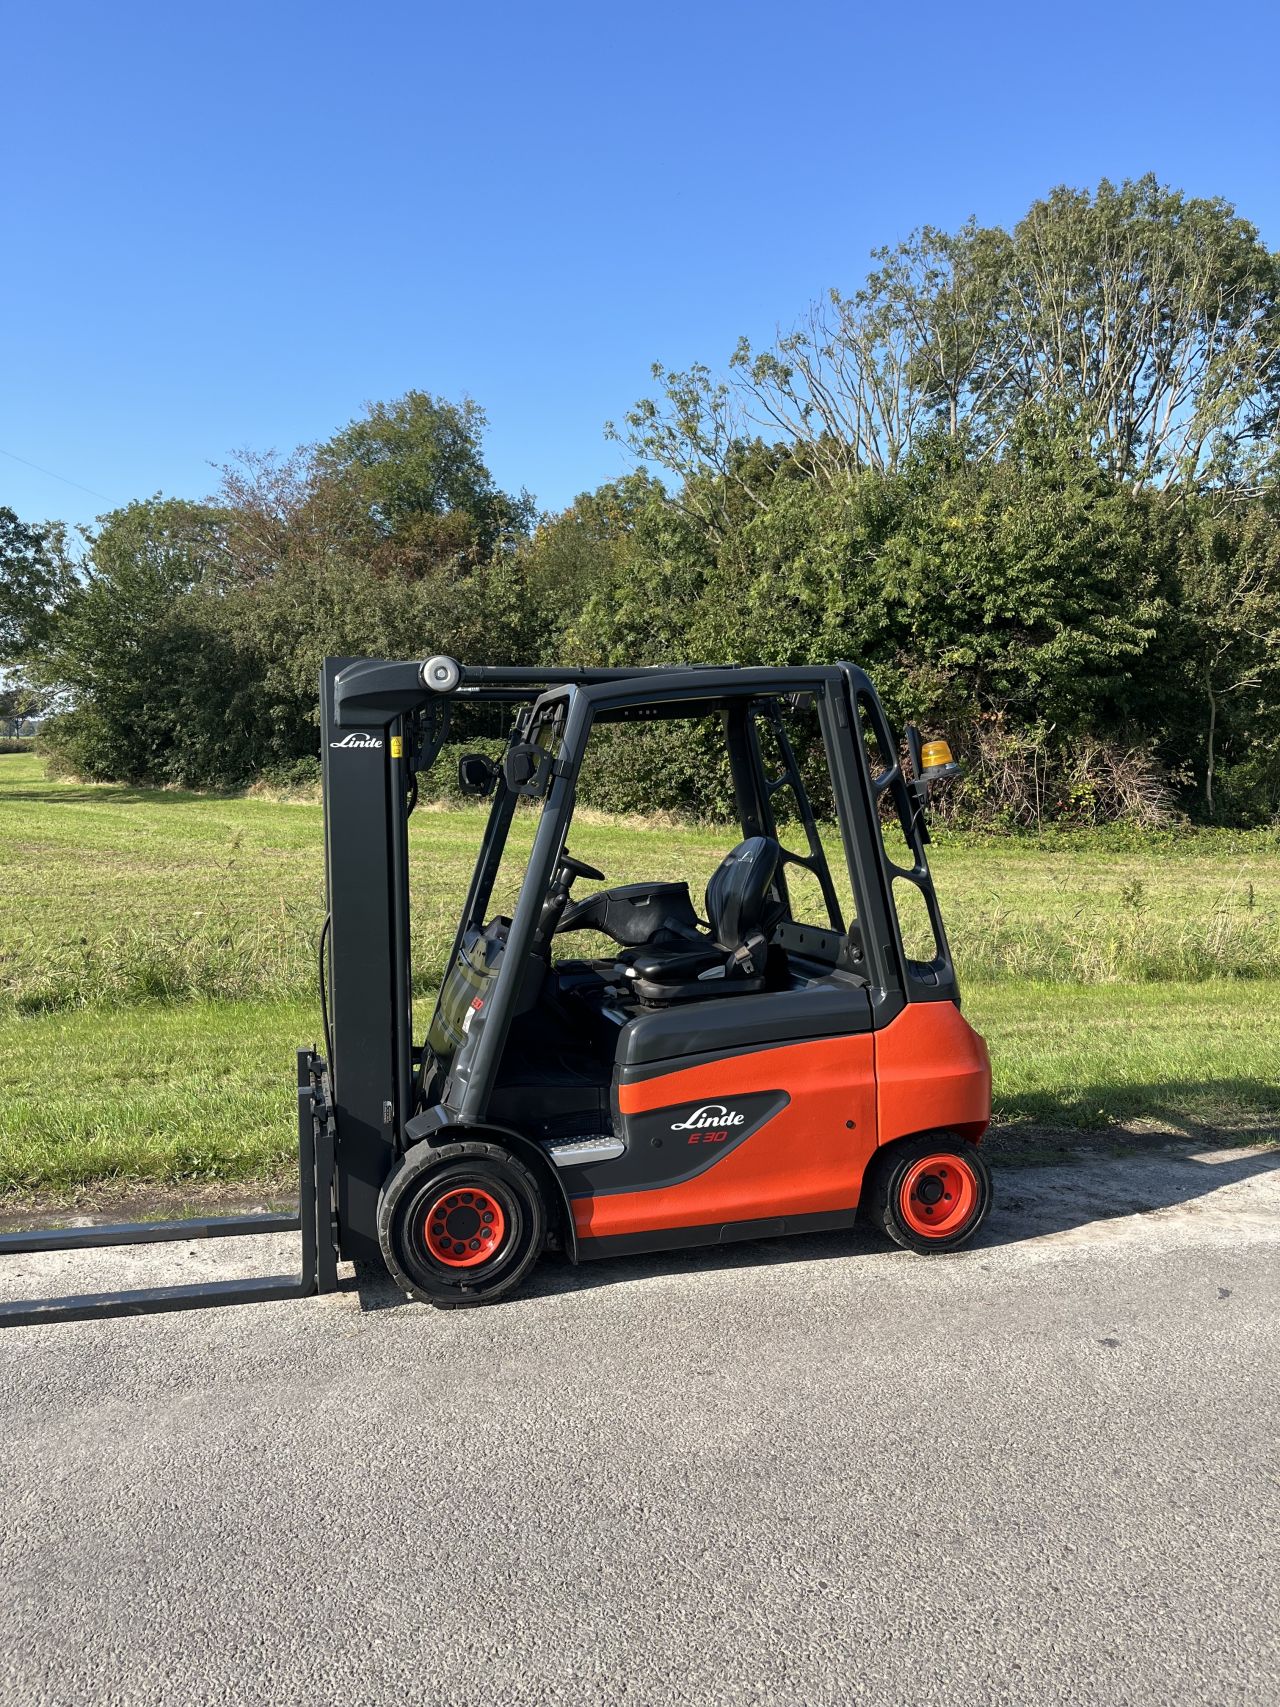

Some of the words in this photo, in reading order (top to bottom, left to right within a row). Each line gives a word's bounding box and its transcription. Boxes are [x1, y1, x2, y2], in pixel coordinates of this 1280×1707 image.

[330, 732, 383, 748] Linde
[670, 1104, 745, 1131] Linde
[688, 1133, 702, 1144] E
[702, 1131, 728, 1143] 30
